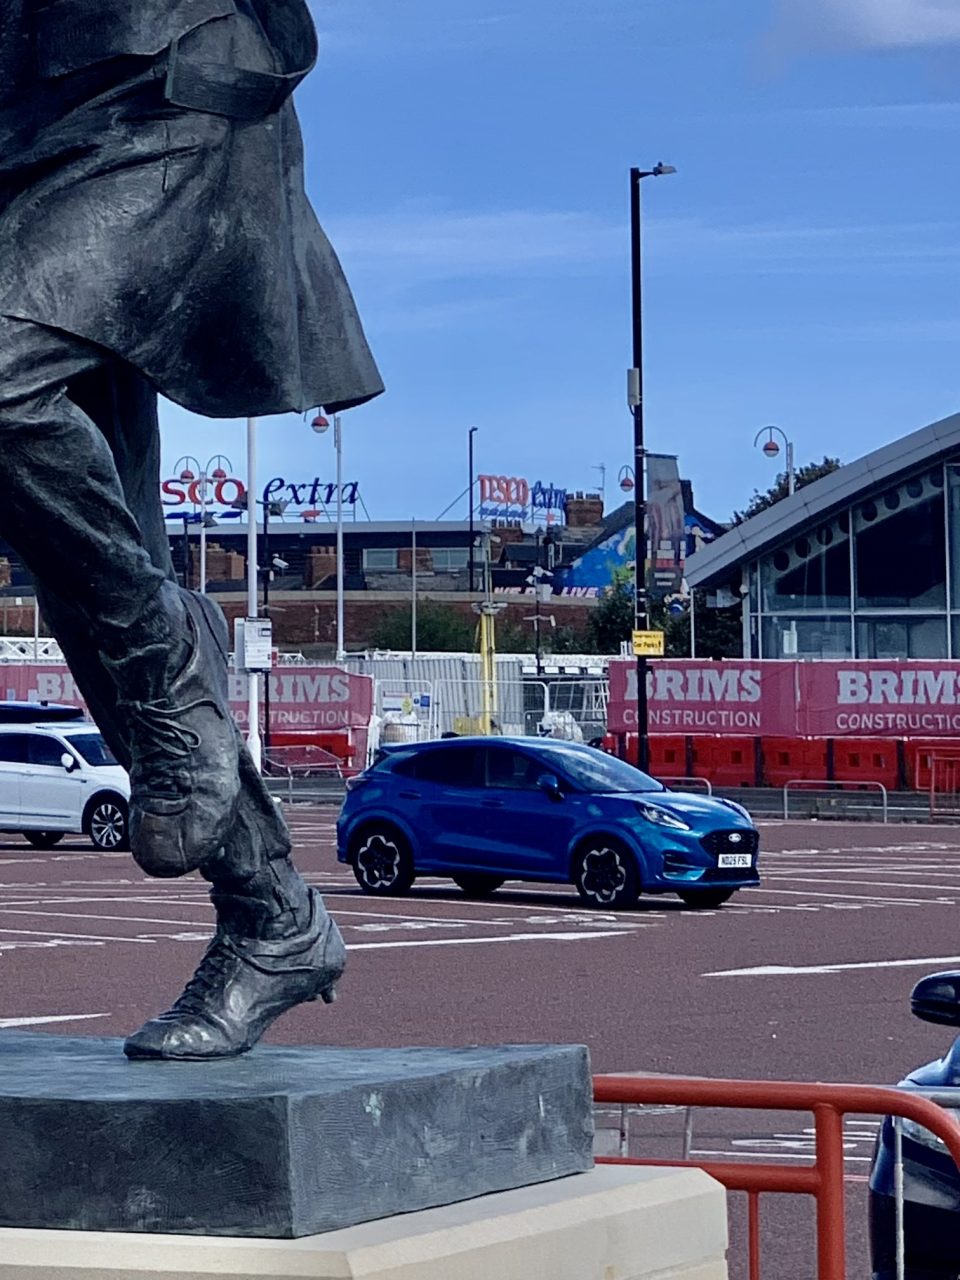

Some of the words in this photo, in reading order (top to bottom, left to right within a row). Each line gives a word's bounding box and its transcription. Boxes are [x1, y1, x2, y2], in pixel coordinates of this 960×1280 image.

[162, 478, 246, 506] SCO
[262, 477, 359, 506] extra
[478, 474, 529, 507] TESCO
[561, 587, 598, 599] LIVE
[624, 669, 762, 702] BRIMS
[837, 670, 960, 704] BRIM
[623, 709, 761, 727] CNSTRUCTION
[836, 713, 960, 730] CONSTRUCTIO
